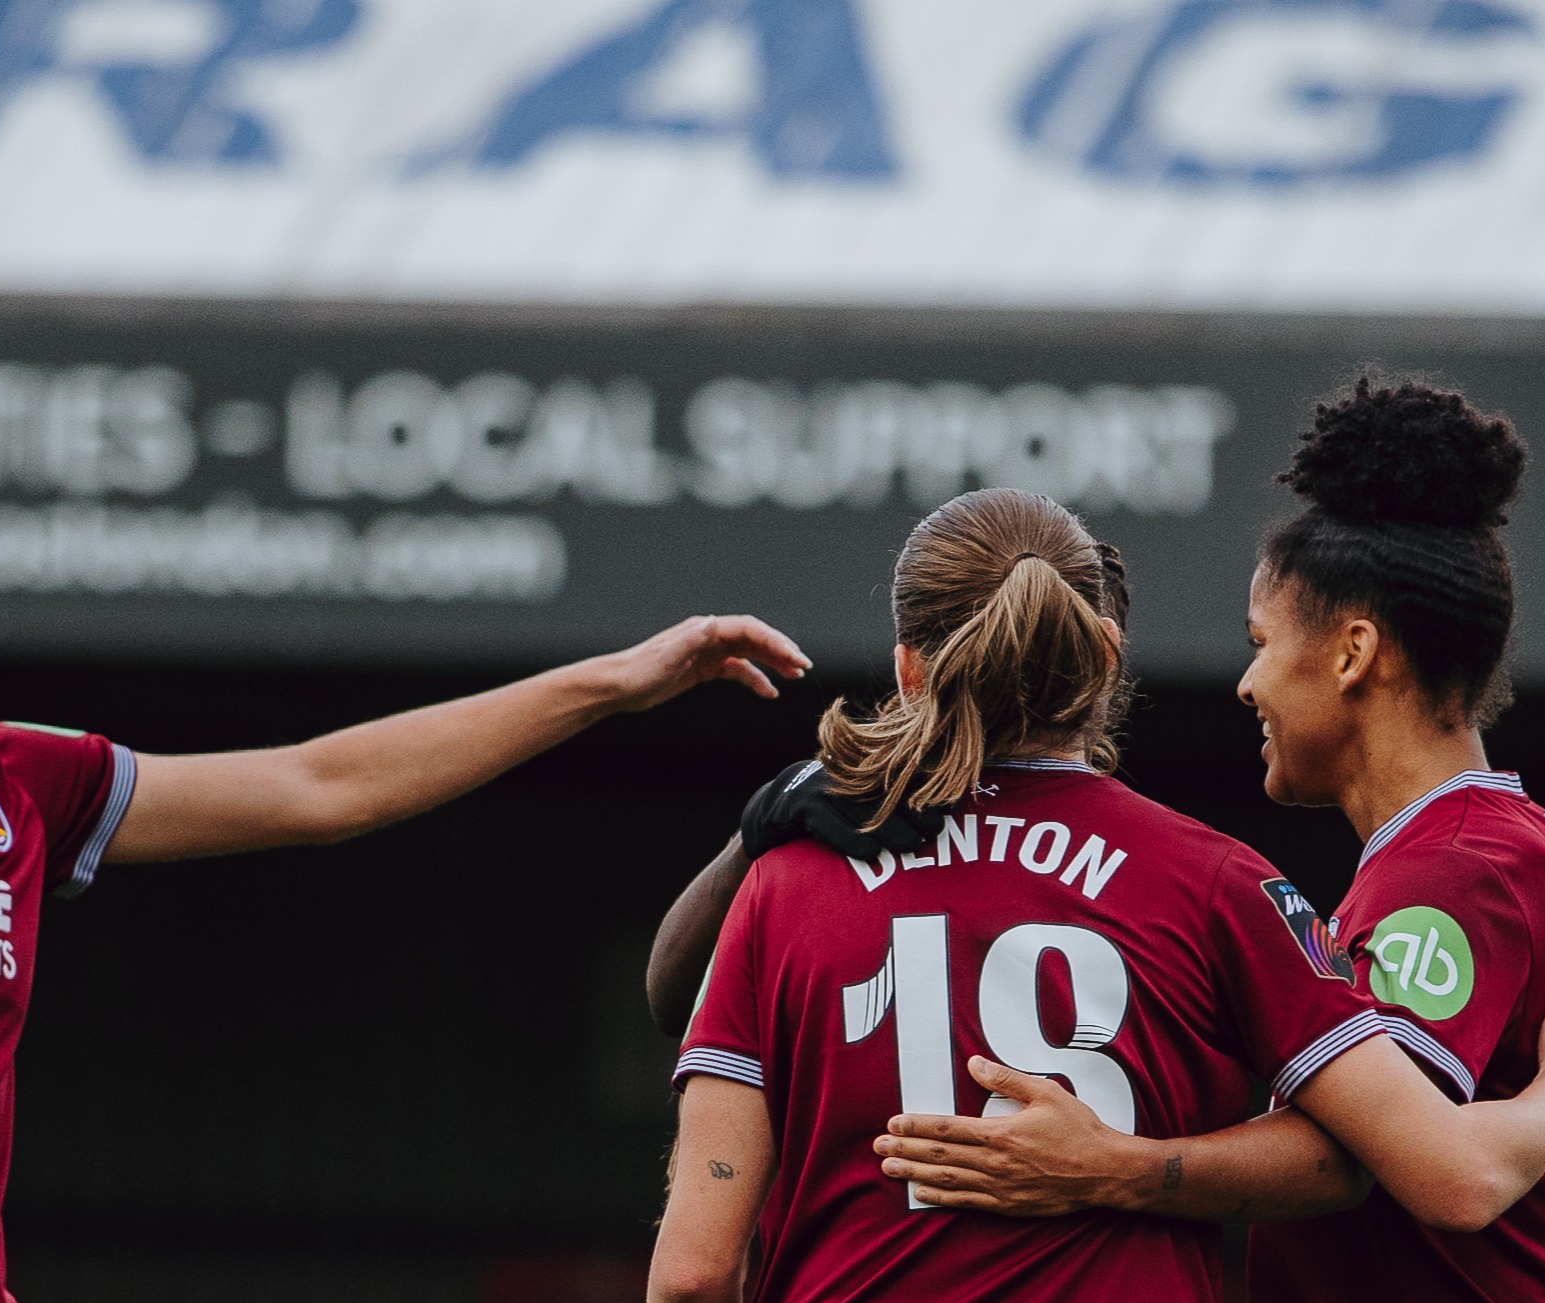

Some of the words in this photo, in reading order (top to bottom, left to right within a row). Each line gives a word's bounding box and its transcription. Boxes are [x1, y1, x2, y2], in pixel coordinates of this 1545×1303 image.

[284, 369, 659, 506] LOCAL
[684, 375, 1236, 512] SUPPORT
[843, 914, 1136, 1209] 18
